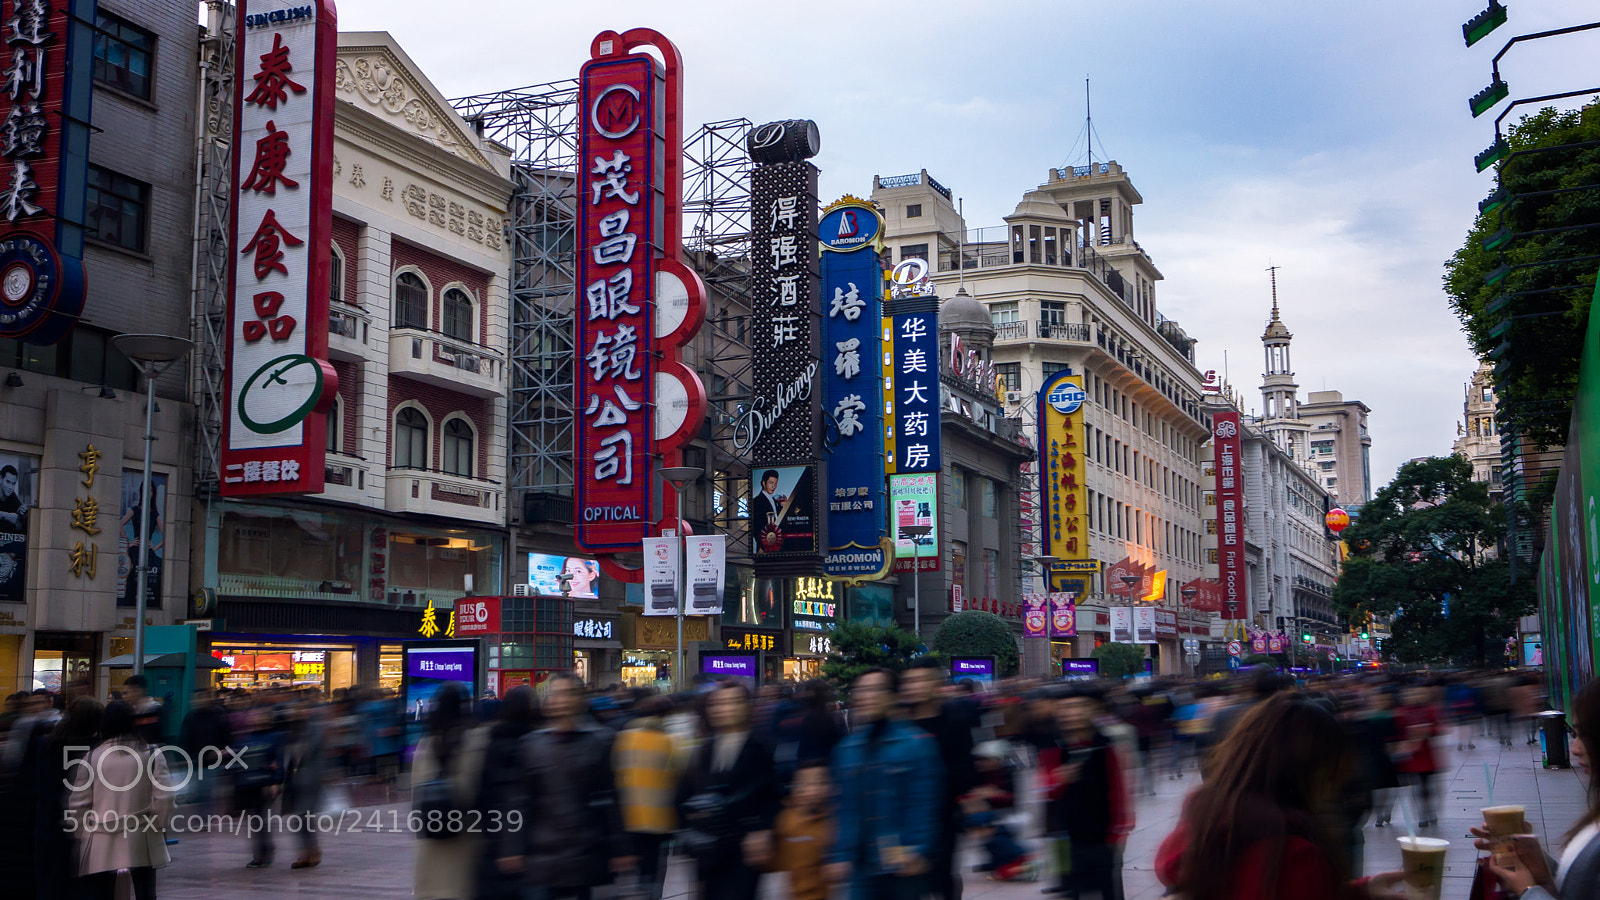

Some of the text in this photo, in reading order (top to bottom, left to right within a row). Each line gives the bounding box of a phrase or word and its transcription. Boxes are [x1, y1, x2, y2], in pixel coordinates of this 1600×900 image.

[241, 33, 307, 342] 泰康食品
[830, 236, 866, 246] BAROMON
[585, 150, 642, 485] 茂昌眼镜公司
[901, 317, 931, 469] 华美大药房
[1049, 391, 1086, 404] BAC
[733, 360, 819, 457] Duchamp
[224, 460, 300, 483] 二楼餐饮
[1221, 444, 1237, 545] 上海市第一食品商店
[584, 505, 641, 522] OPTICAL
[829, 500, 874, 511] 西服公司
[824, 552, 881, 564] BAROMON
[1226, 551, 1236, 569] First
[459, 603, 475, 615] BUS
[793, 600, 835, 617] SILK KING
[573, 619, 612, 639] 眼镜公司
